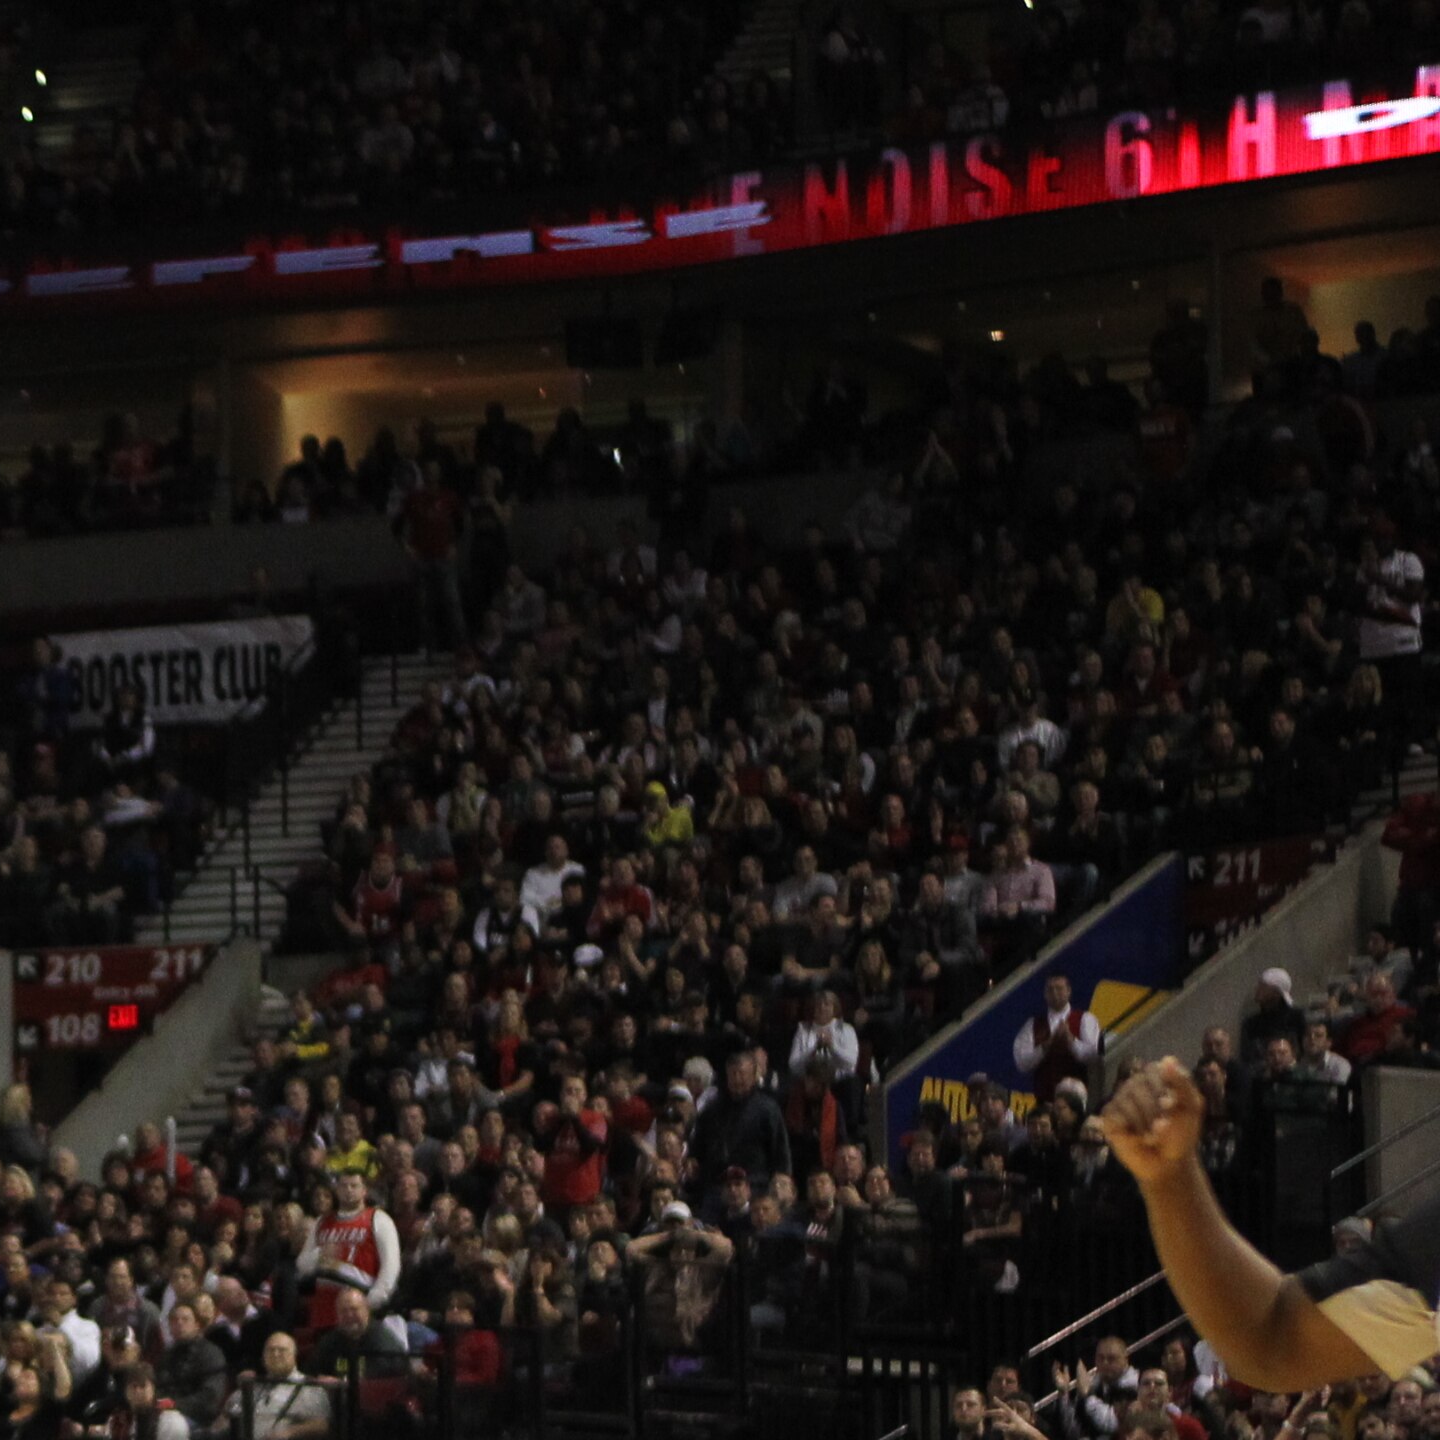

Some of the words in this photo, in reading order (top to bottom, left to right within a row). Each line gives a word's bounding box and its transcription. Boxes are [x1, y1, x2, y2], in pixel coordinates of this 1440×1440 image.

[1213, 848, 1261, 887] 211
[44, 951, 102, 987] 210
[148, 947, 204, 982] 211
[46, 1012, 101, 1046] 108
[108, 1004, 138, 1030] EXIT
